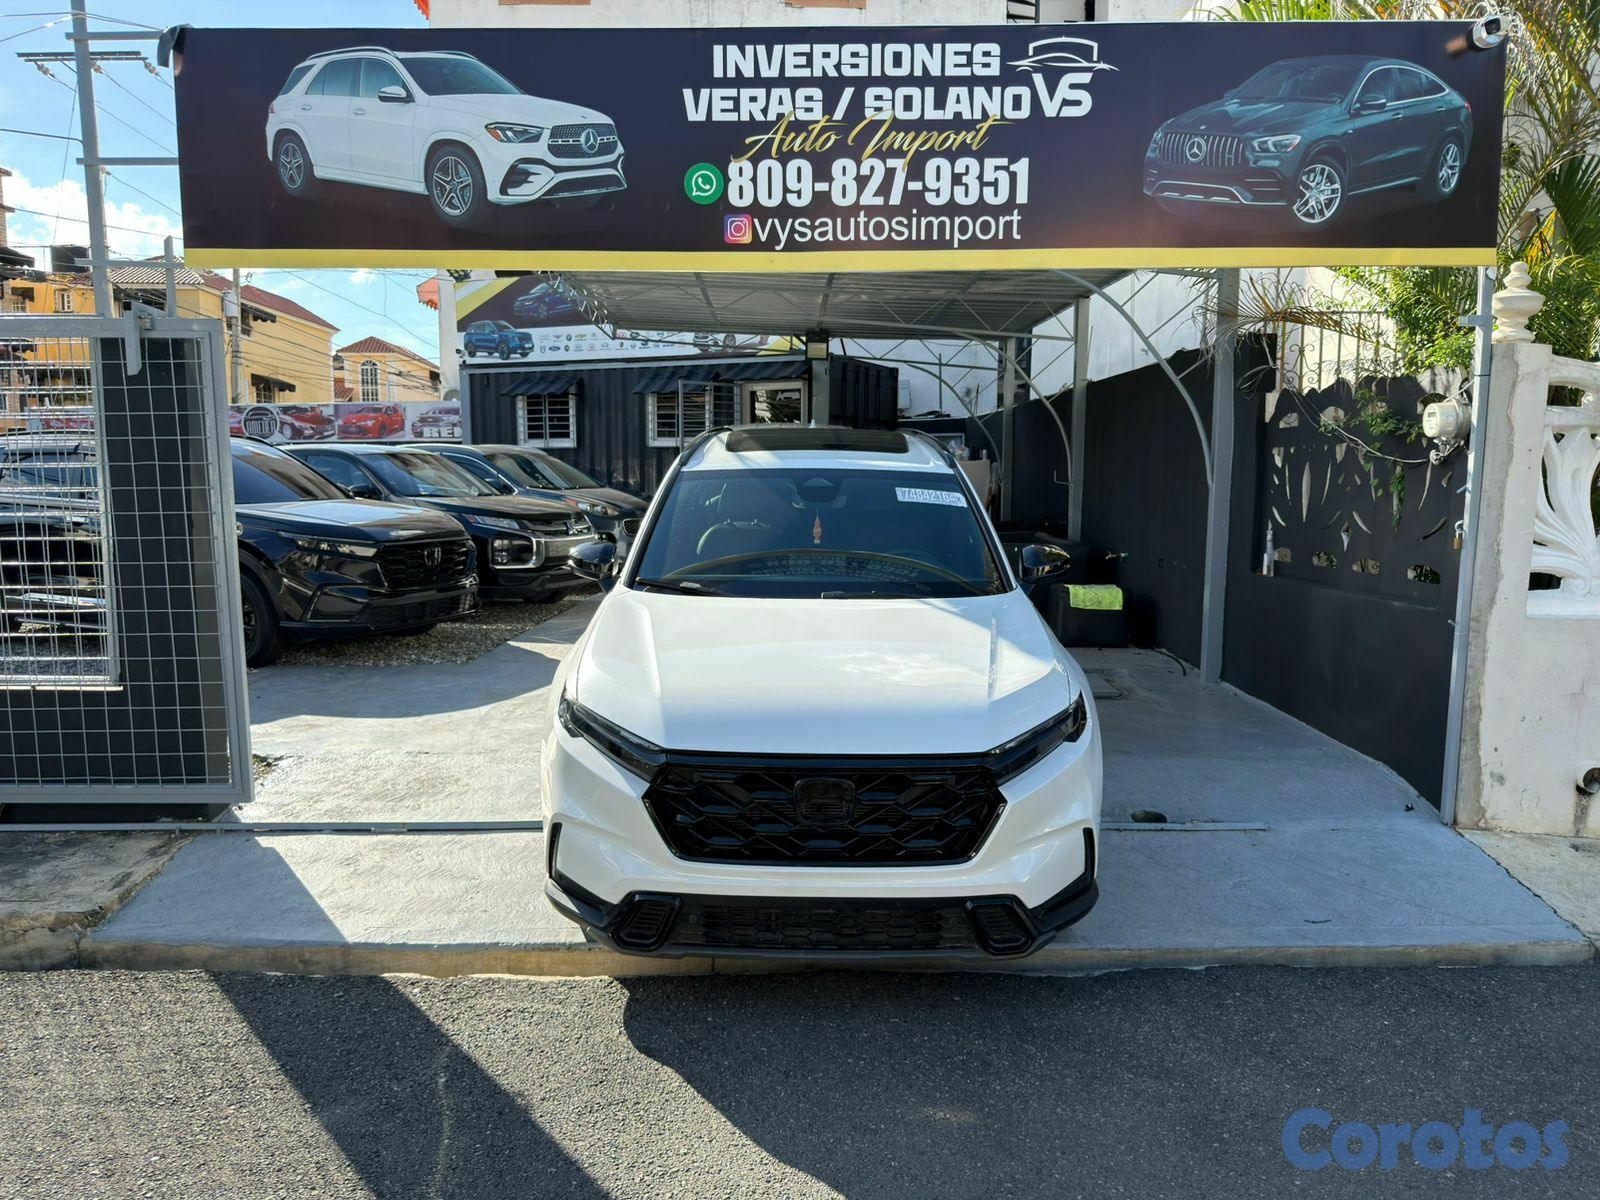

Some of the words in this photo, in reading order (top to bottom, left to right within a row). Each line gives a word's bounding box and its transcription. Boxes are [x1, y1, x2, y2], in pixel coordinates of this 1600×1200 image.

[712, 43, 1001, 78] INVERSIONES
[682, 87, 823, 122] VERAS
[864, 86, 1032, 121] SOLANO
[1031, 72, 1093, 118] VS
[730, 110, 848, 163] Auto
[847, 109, 1016, 173] Import
[727, 157, 1030, 208] 809-827-9351
[753, 208, 1022, 250] vysautosimport
